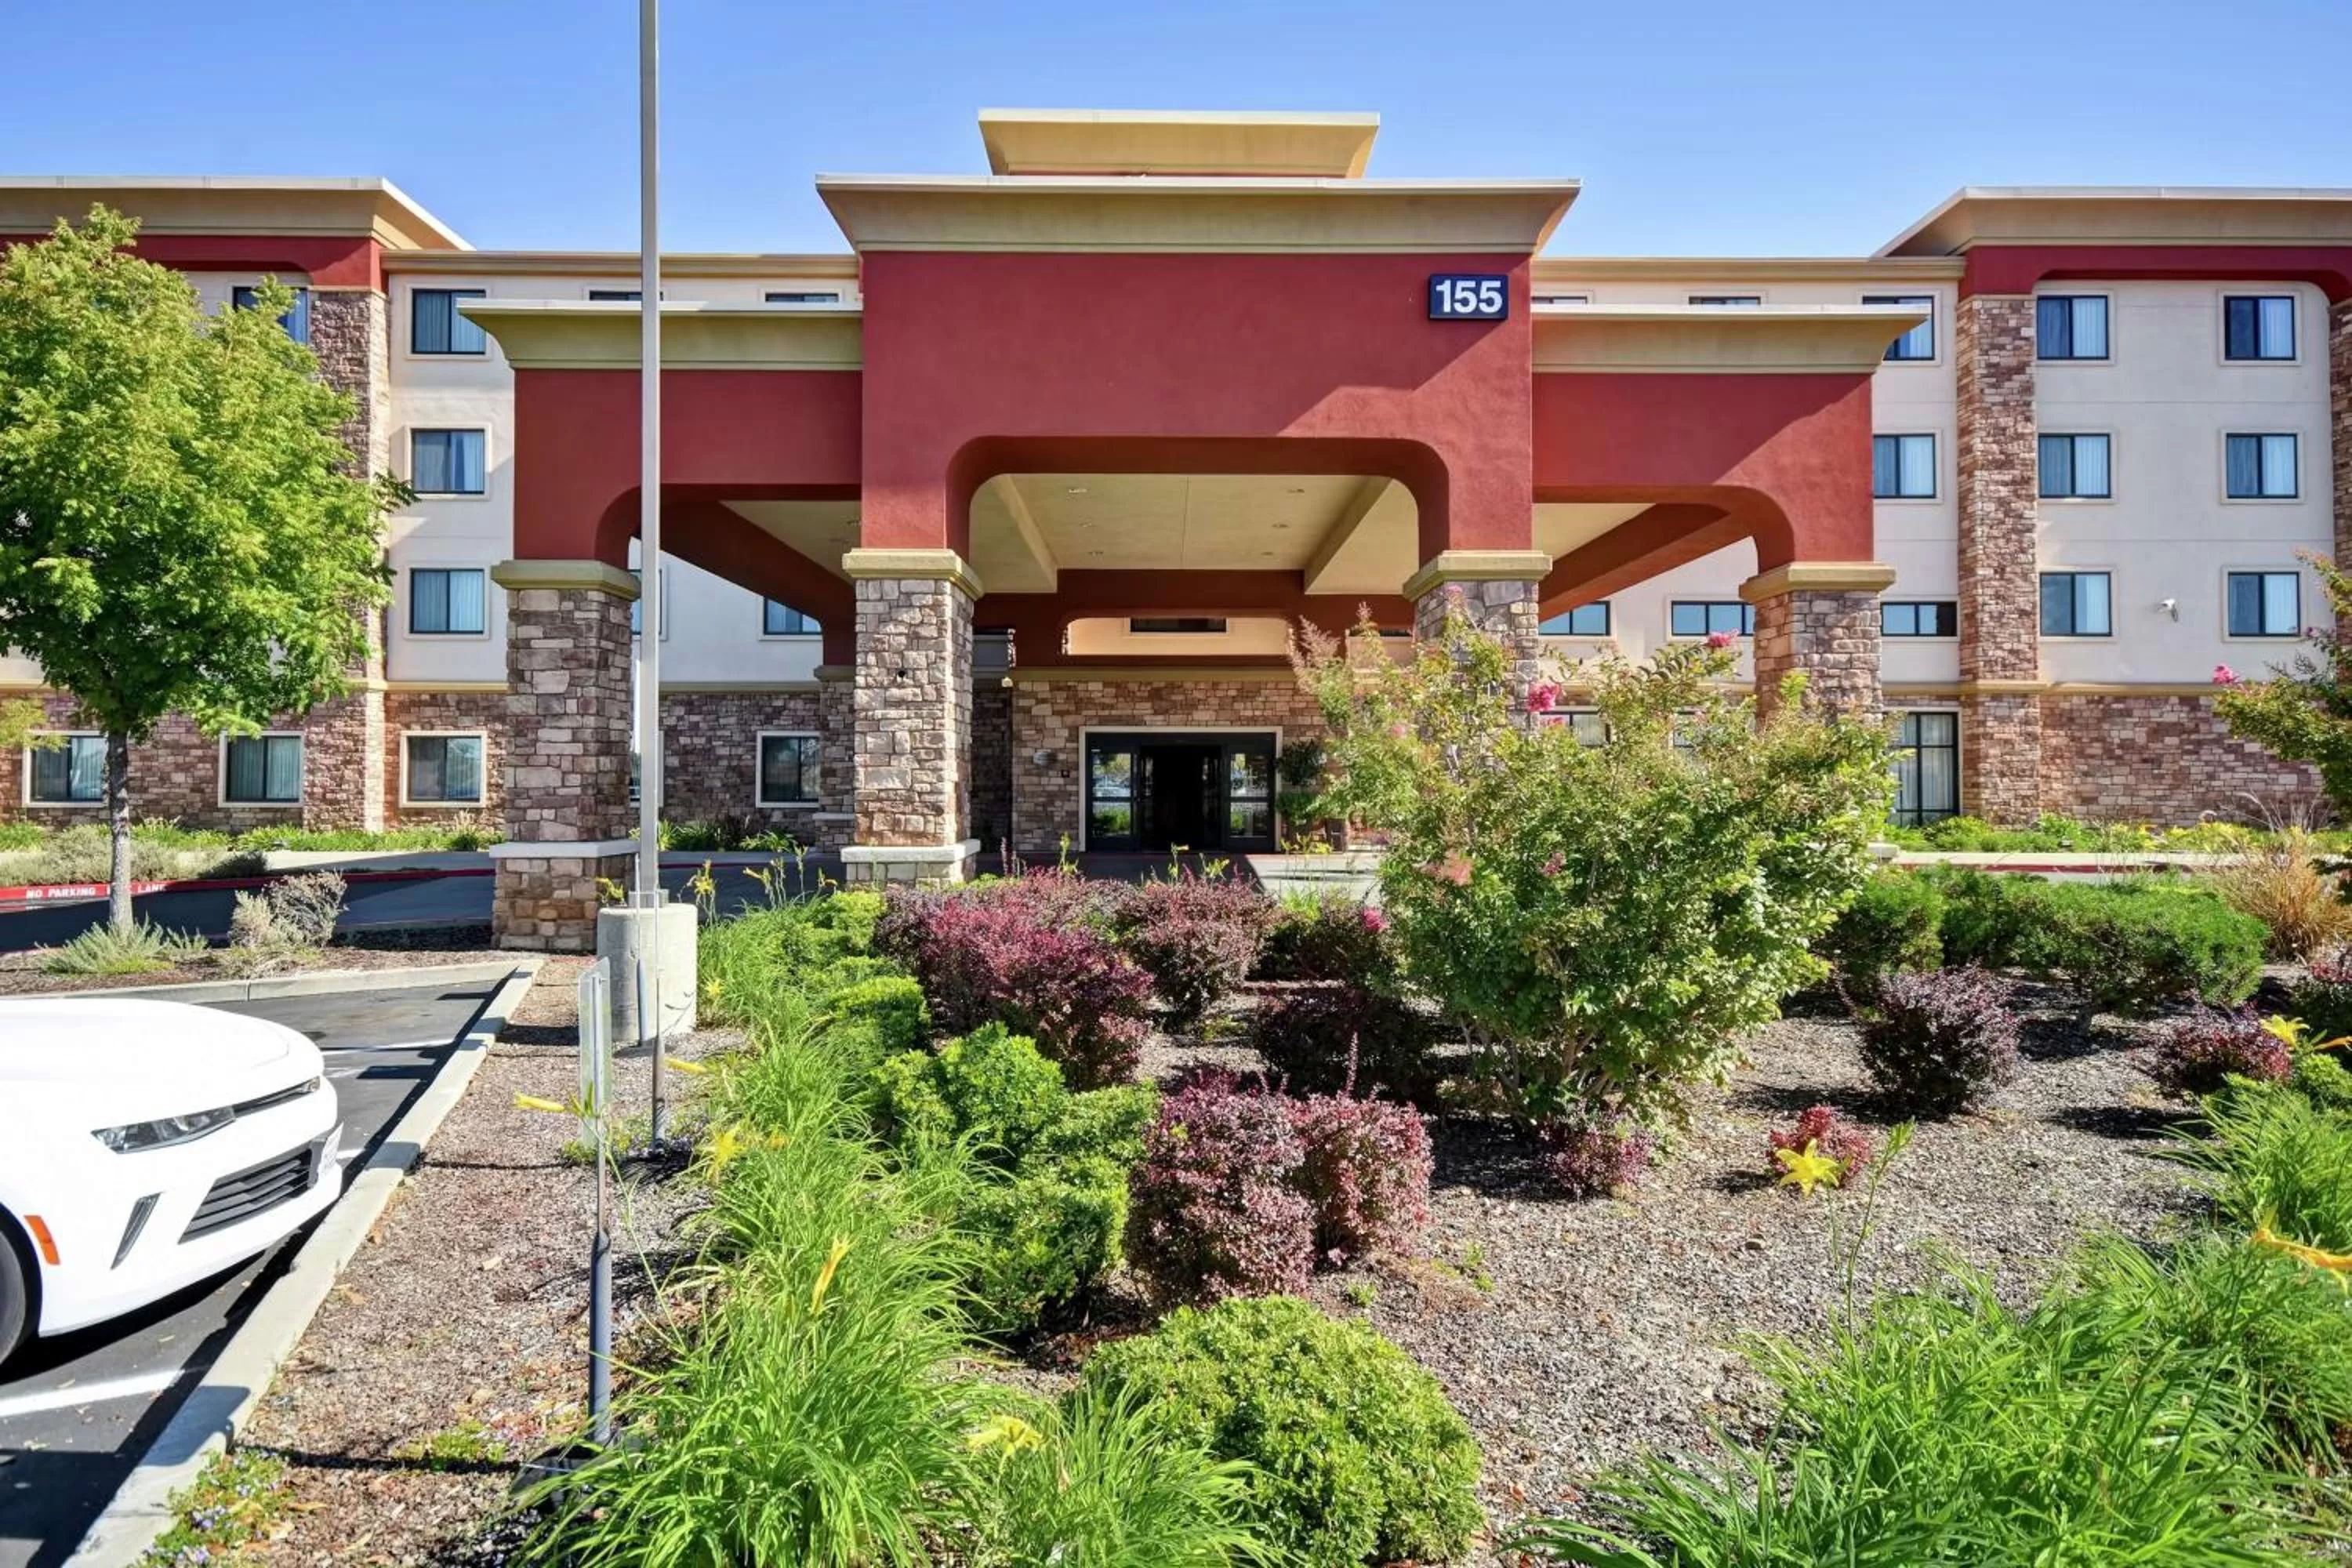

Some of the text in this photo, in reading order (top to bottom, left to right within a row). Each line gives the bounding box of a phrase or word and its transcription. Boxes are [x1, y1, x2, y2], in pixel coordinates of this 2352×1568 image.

[1436, 279, 1503, 314] 155
[26, 890, 43, 898] NO
[48, 887, 96, 898] PARKING
